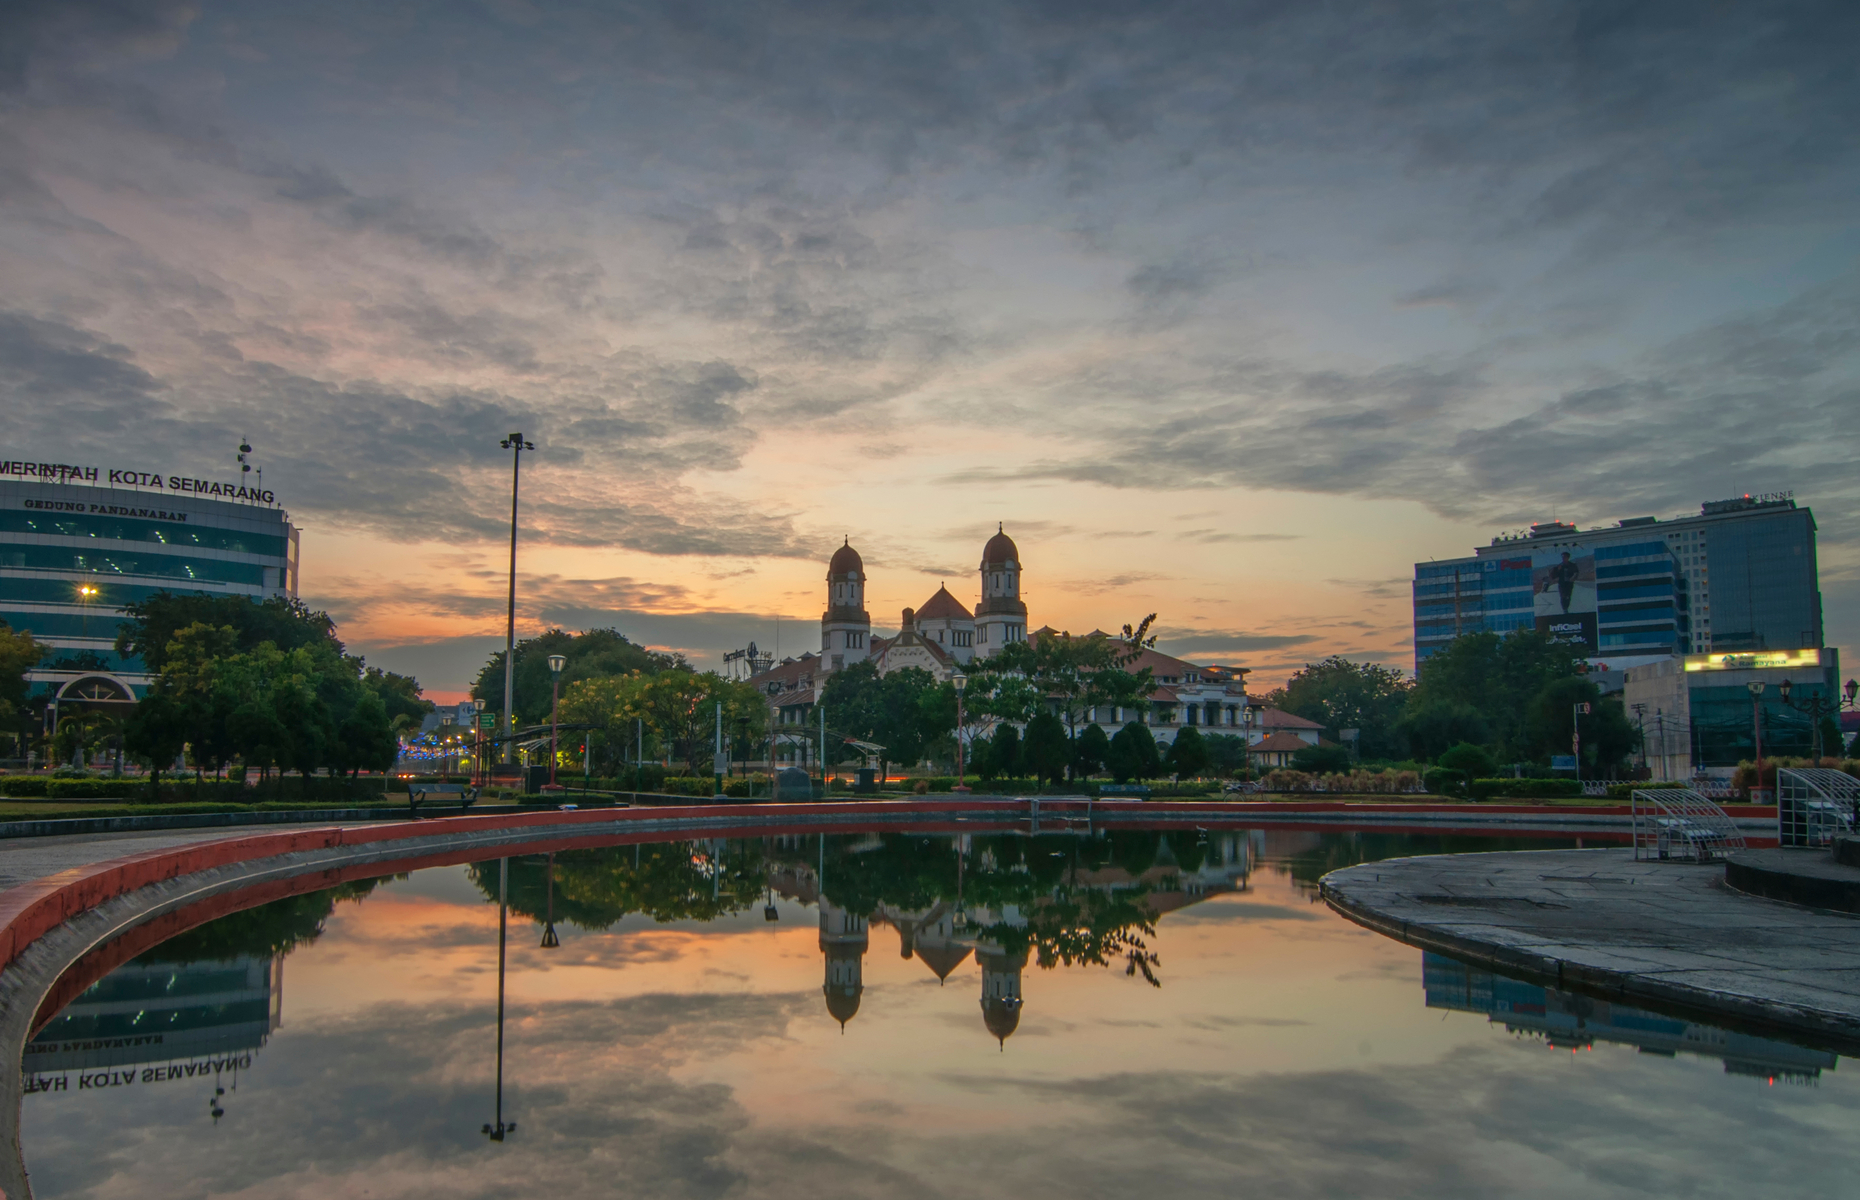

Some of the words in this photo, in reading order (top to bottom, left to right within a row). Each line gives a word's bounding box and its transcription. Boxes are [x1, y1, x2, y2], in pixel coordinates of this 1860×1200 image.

[109, 469, 164, 488] KOTA
[169, 476, 275, 503] SEMARANG
[24, 499, 86, 512] GEDUNG
[90, 503, 188, 522] PANDANARAN
[1738, 659, 1787, 667] Ramayana
